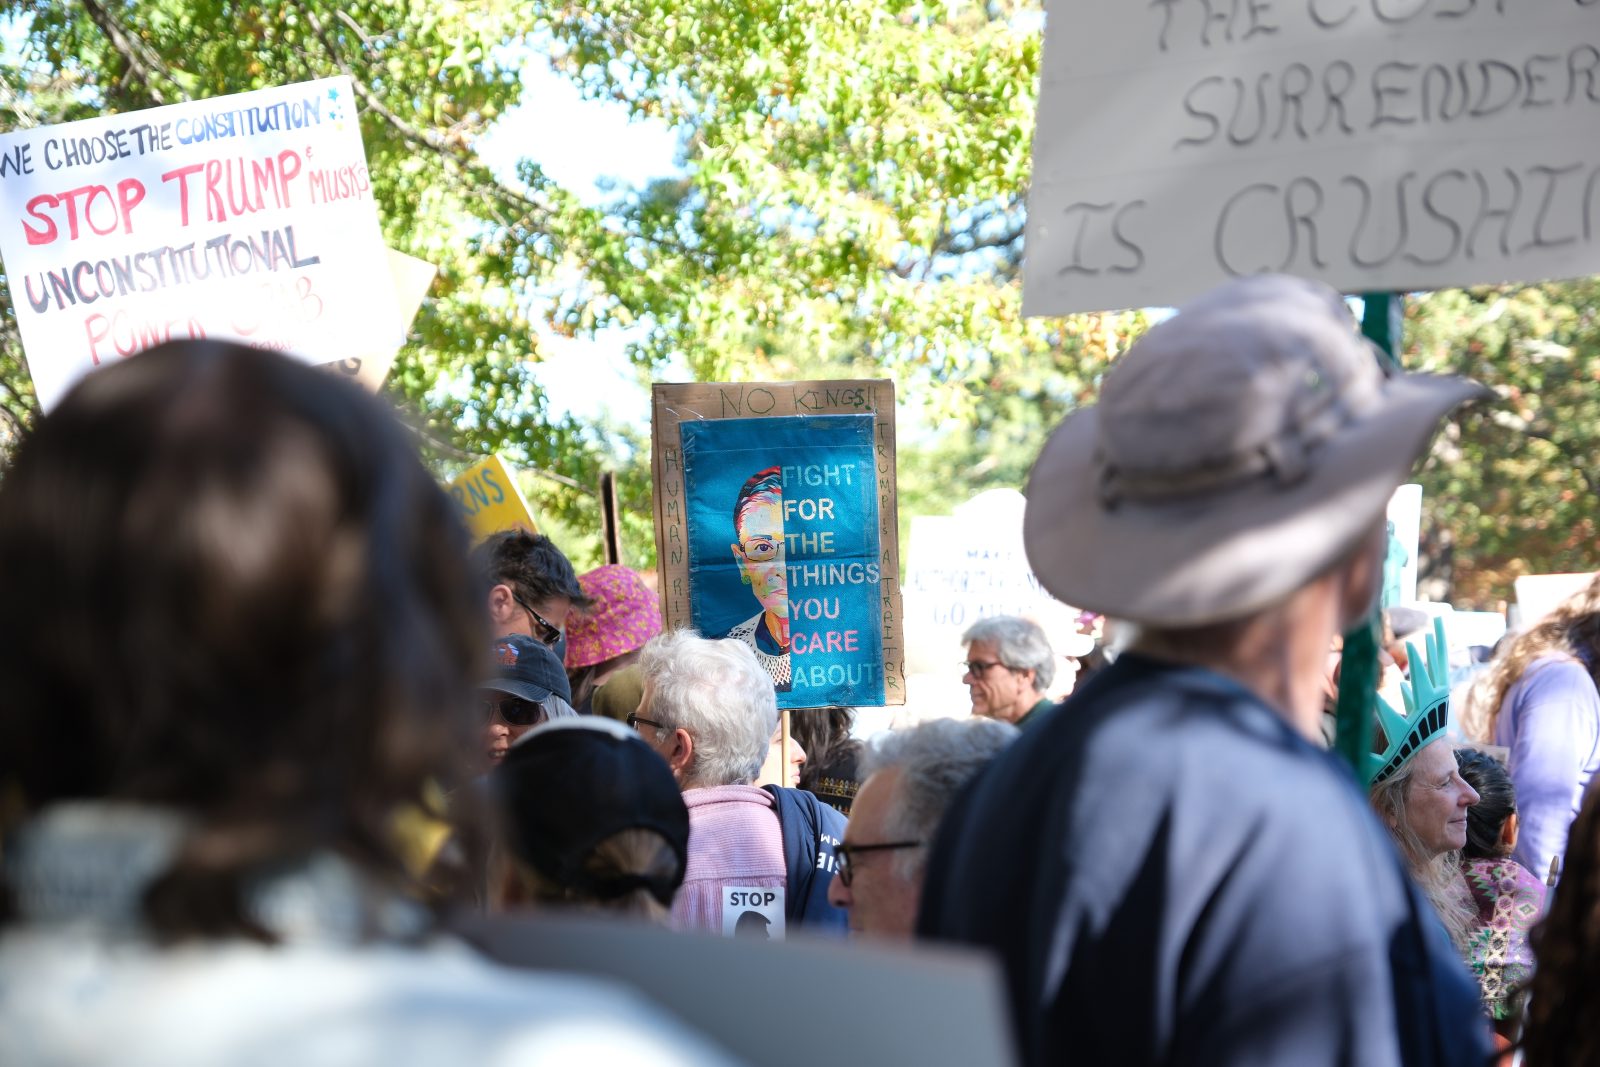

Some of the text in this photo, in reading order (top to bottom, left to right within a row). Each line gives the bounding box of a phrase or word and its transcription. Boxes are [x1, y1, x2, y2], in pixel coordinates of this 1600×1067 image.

[1172, 44, 1600, 151] SURRENDER
[0, 95, 321, 178] WE CHOOSE THE CONSTITUTION
[21, 178, 146, 246] STOP
[162, 149, 302, 228] TRUMP
[1057, 199, 1146, 277] IS
[24, 225, 320, 313] UNCONSTITUTIONAL
[719, 386, 776, 416] NO
[782, 464, 855, 488] FIGHT
[877, 422, 892, 509] TRUMP
[665, 449, 683, 565] HUMAN
[783, 498, 835, 522] FOR
[784, 531, 835, 555] THE
[882, 549, 891, 566] A
[787, 563, 880, 588] THINGS
[789, 598, 840, 621] YOU
[790, 630, 860, 655] CARE
[880, 577, 900, 690] TRAITOR
[791, 662, 877, 689] ABOUT
[730, 891, 776, 907] STOP
